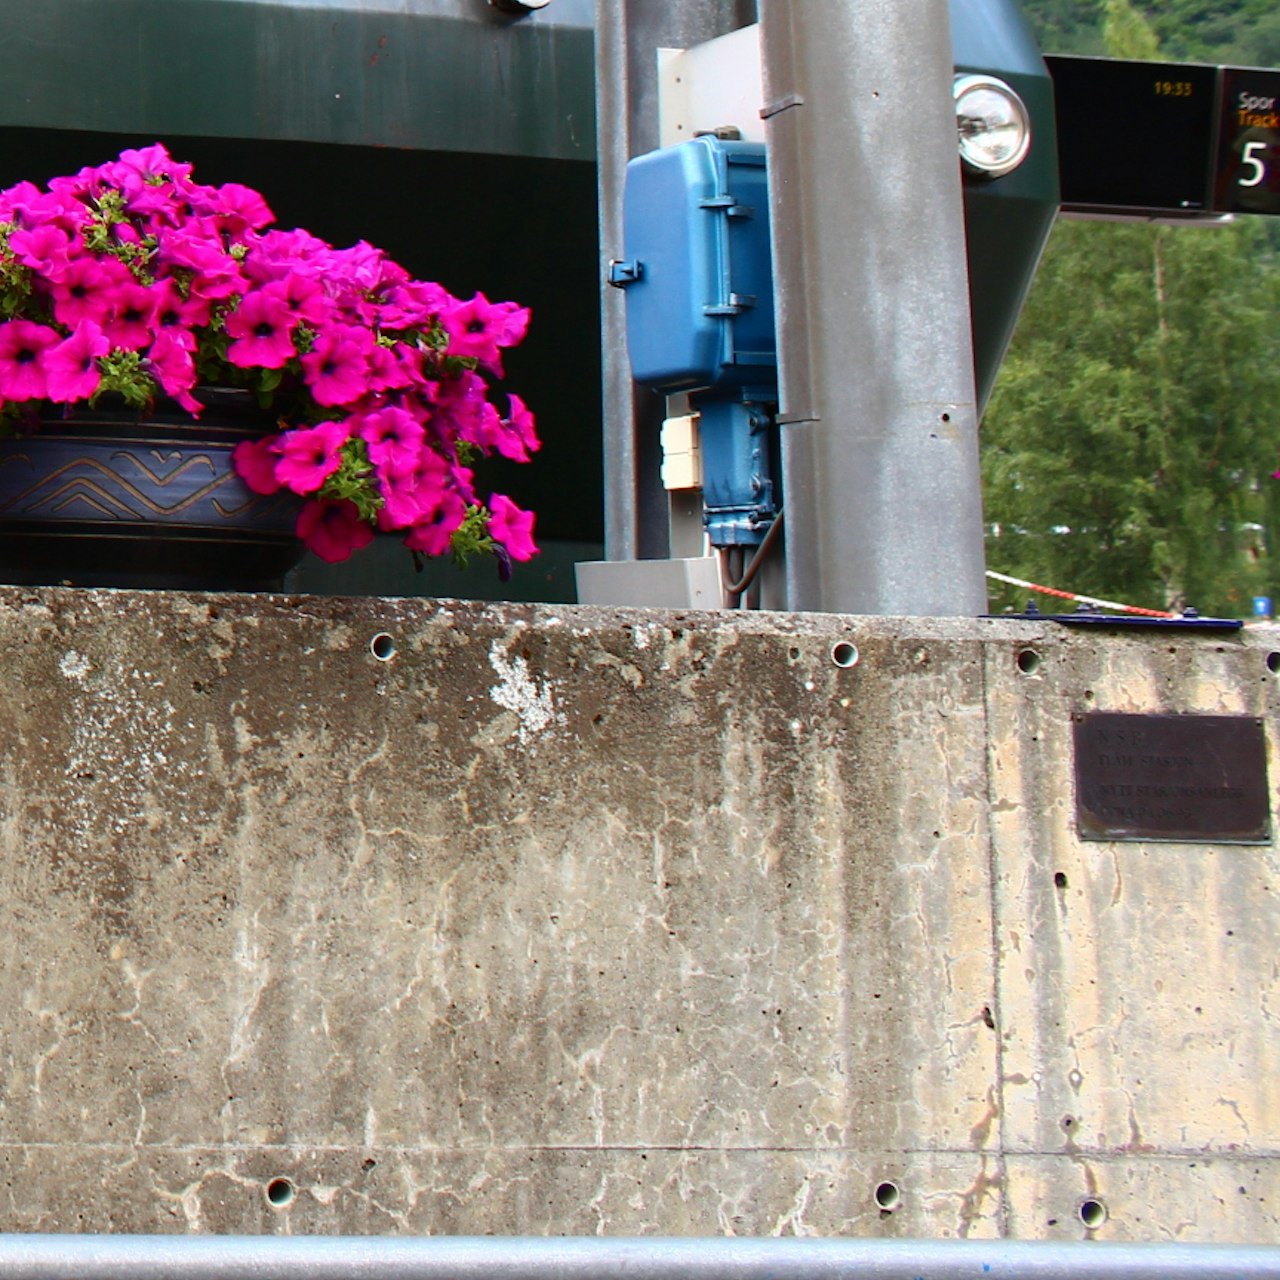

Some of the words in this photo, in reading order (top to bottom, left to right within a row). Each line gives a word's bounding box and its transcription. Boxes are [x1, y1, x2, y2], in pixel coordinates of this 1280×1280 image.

[1239, 91, 1276, 111] Spor
[1238, 109, 1280, 128] Track
[1238, 141, 1268, 187] 5
